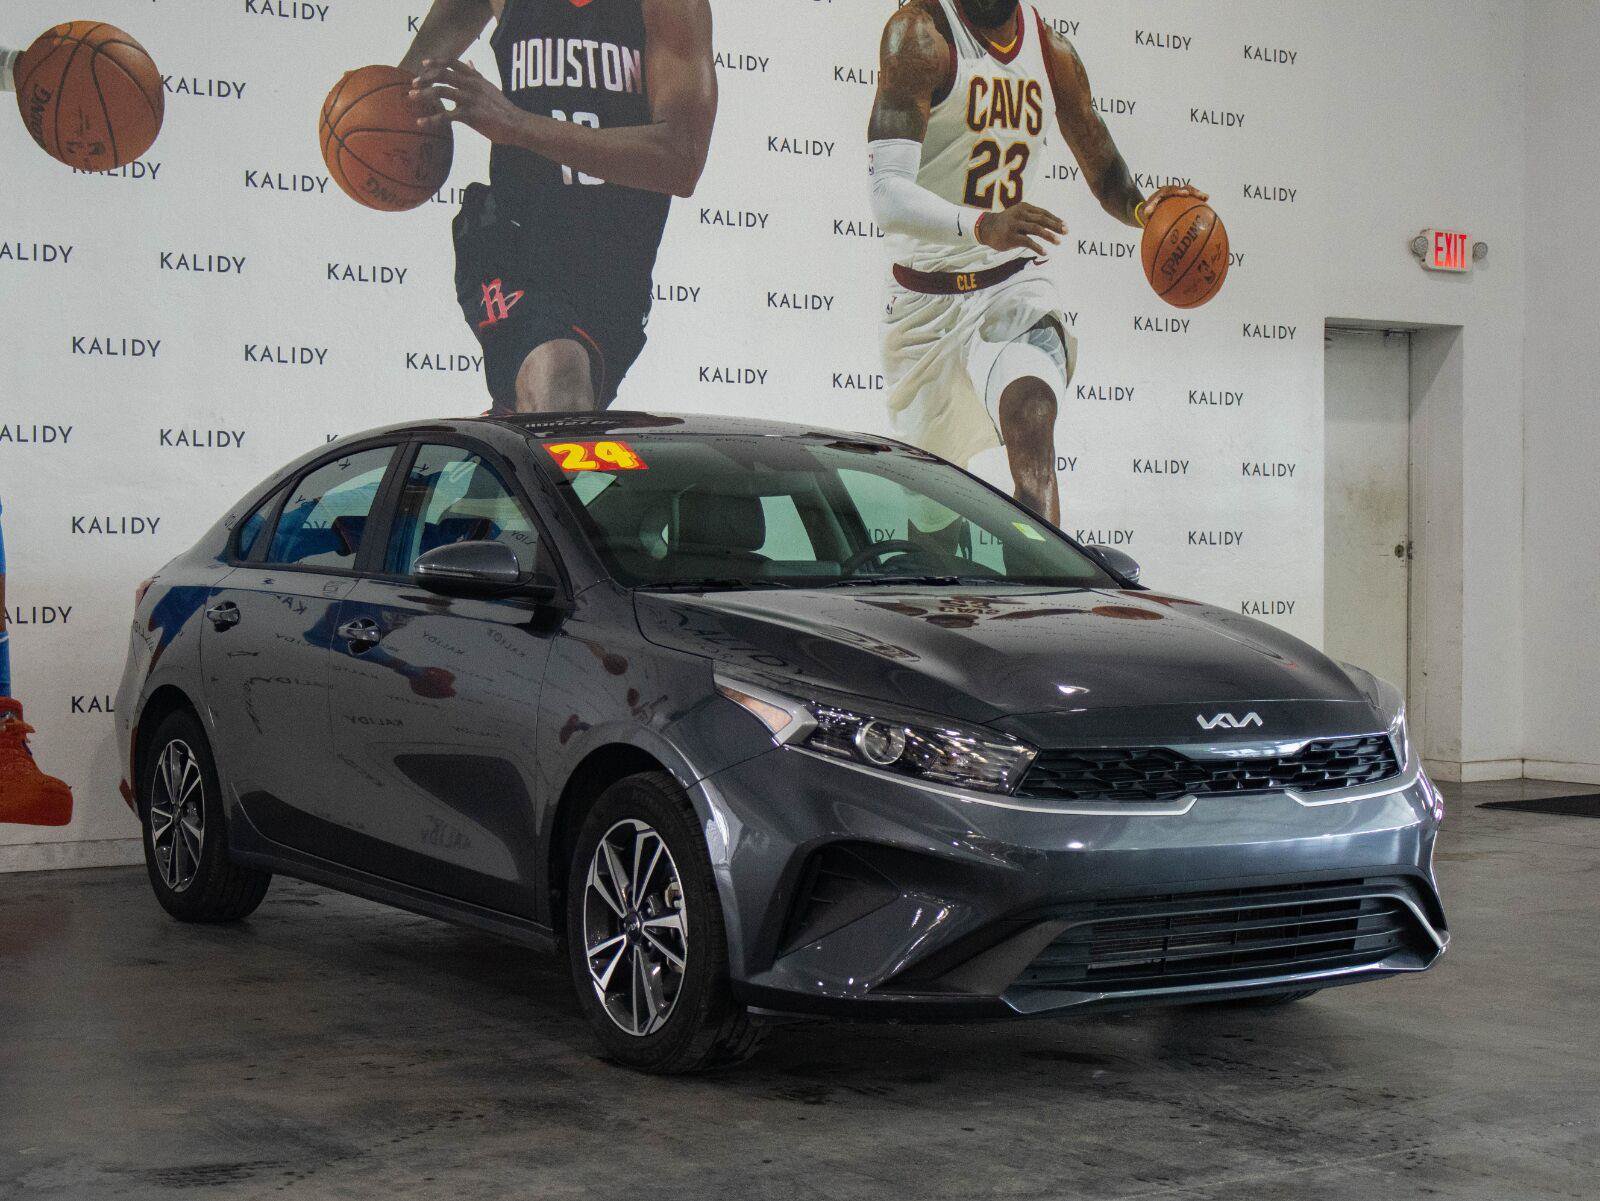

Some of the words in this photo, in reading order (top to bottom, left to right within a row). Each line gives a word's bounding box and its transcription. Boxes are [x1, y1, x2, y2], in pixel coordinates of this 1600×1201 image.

[246, 0, 329, 21] KALIDY
[1136, 30, 1191, 50] KALIDY
[1244, 45, 1297, 64] KALIDY
[511, 38, 642, 94] HOUSTON
[715, 55, 769, 73] ALIDY
[835, 66, 880, 85] KALI
[162, 75, 246, 99] KALIDY
[966, 75, 1042, 136] CAVS
[1091, 98, 1136, 115] ALIDY
[1191, 109, 1244, 127] KALIDY
[768, 136, 834, 156] KALIDY
[246, 170, 329, 193] KALIDY
[963, 138, 1030, 209] 23
[1244, 184, 1296, 202] KALIDY
[701, 209, 768, 228] KALIDY
[0, 242, 73, 263] ALIDY
[1078, 240, 1135, 258] KALIDY
[1434, 231, 1467, 268] EXIT
[161, 252, 245, 273] KALIDY
[328, 263, 407, 284] KALIDY
[957, 272, 978, 291] CLE
[651, 285, 700, 302] LIDY
[768, 292, 833, 310] KALIDY
[1135, 316, 1189, 333] KALIDY
[1243, 324, 1296, 339] KALIDY
[73, 337, 160, 357] KALIDY
[245, 345, 328, 364] KALIDY
[407, 352, 484, 372] KALIDY
[700, 367, 767, 384] KALIDY
[833, 373, 883, 389] KALID
[1077, 385, 1134, 401] KALIDY
[1189, 390, 1243, 405] KALIDY
[0, 424, 72, 443] ALIDY
[160, 429, 245, 447] KALIDY
[1134, 459, 1189, 474] KALIDY
[1243, 463, 1295, 477] KALIDY
[72, 516, 160, 534] KALIDY
[1077, 530, 1133, 545] KALIDY
[1189, 531, 1243, 545] KALIDY
[5, 606, 72, 624] ALIDY
[1242, 601, 1294, 614] KALIDY
[72, 695, 114, 713] KAL
